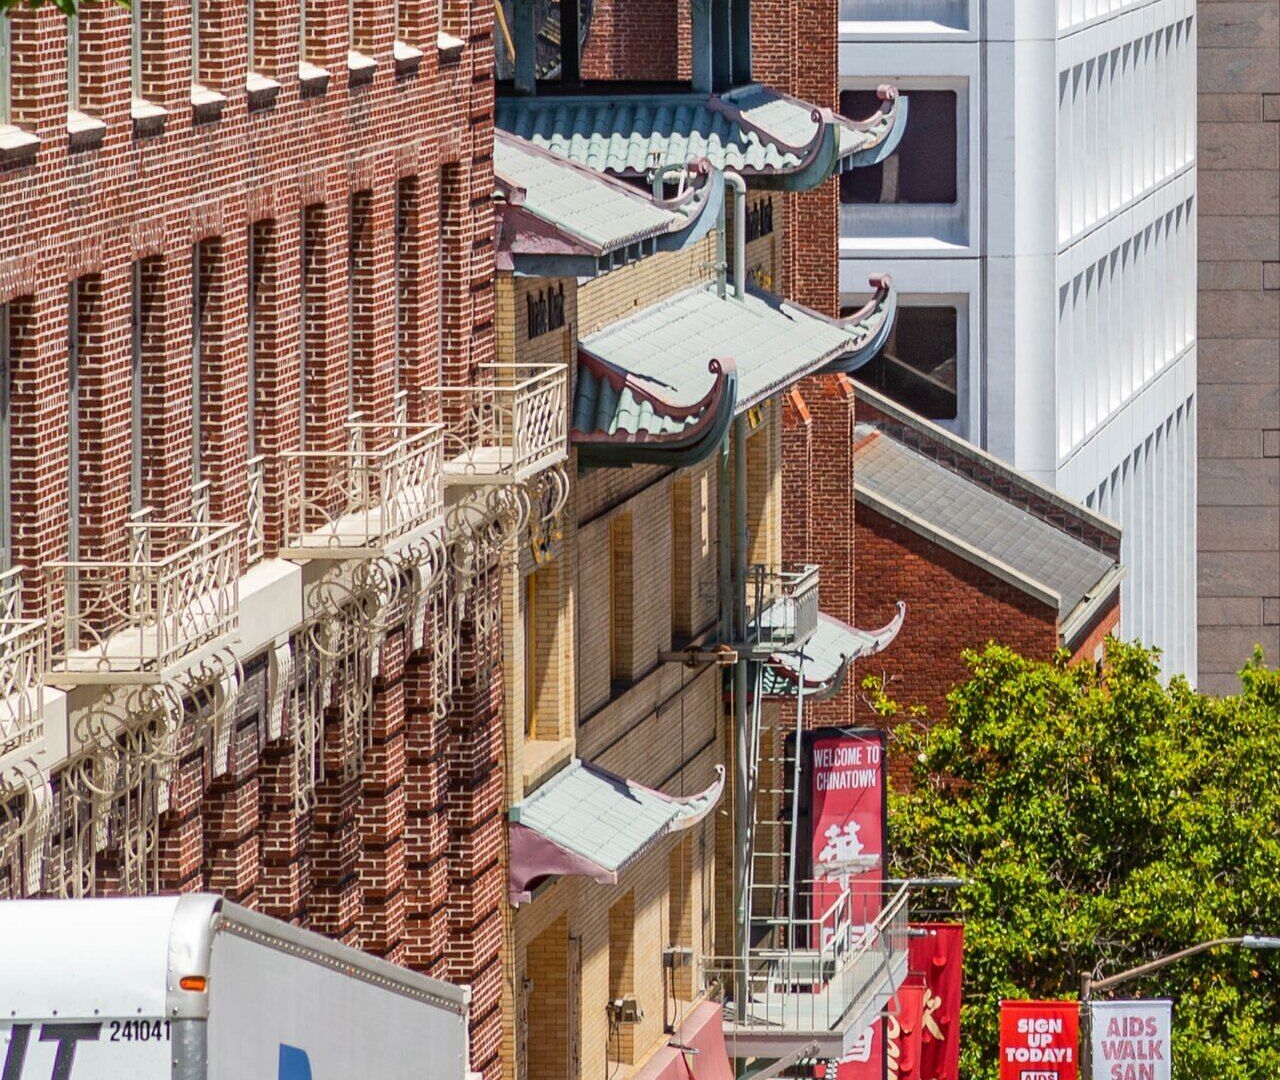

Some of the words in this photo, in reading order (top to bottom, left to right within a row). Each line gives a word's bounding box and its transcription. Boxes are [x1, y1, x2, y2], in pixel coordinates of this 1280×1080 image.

[813, 746, 862, 769] WELCOME
[866, 744, 879, 765] TO
[816, 769, 876, 792] CHINATOWN
[109, 1020, 171, 1042] 241041
[1017, 1018, 1063, 1034] SIGN
[1106, 1016, 1158, 1037] AIDS
[1027, 1033, 1053, 1048] UP
[1101, 1039, 1164, 1061] WALK
[1005, 1047, 1073, 1063] TODAY!
[1111, 1063, 1155, 1080] SAN
